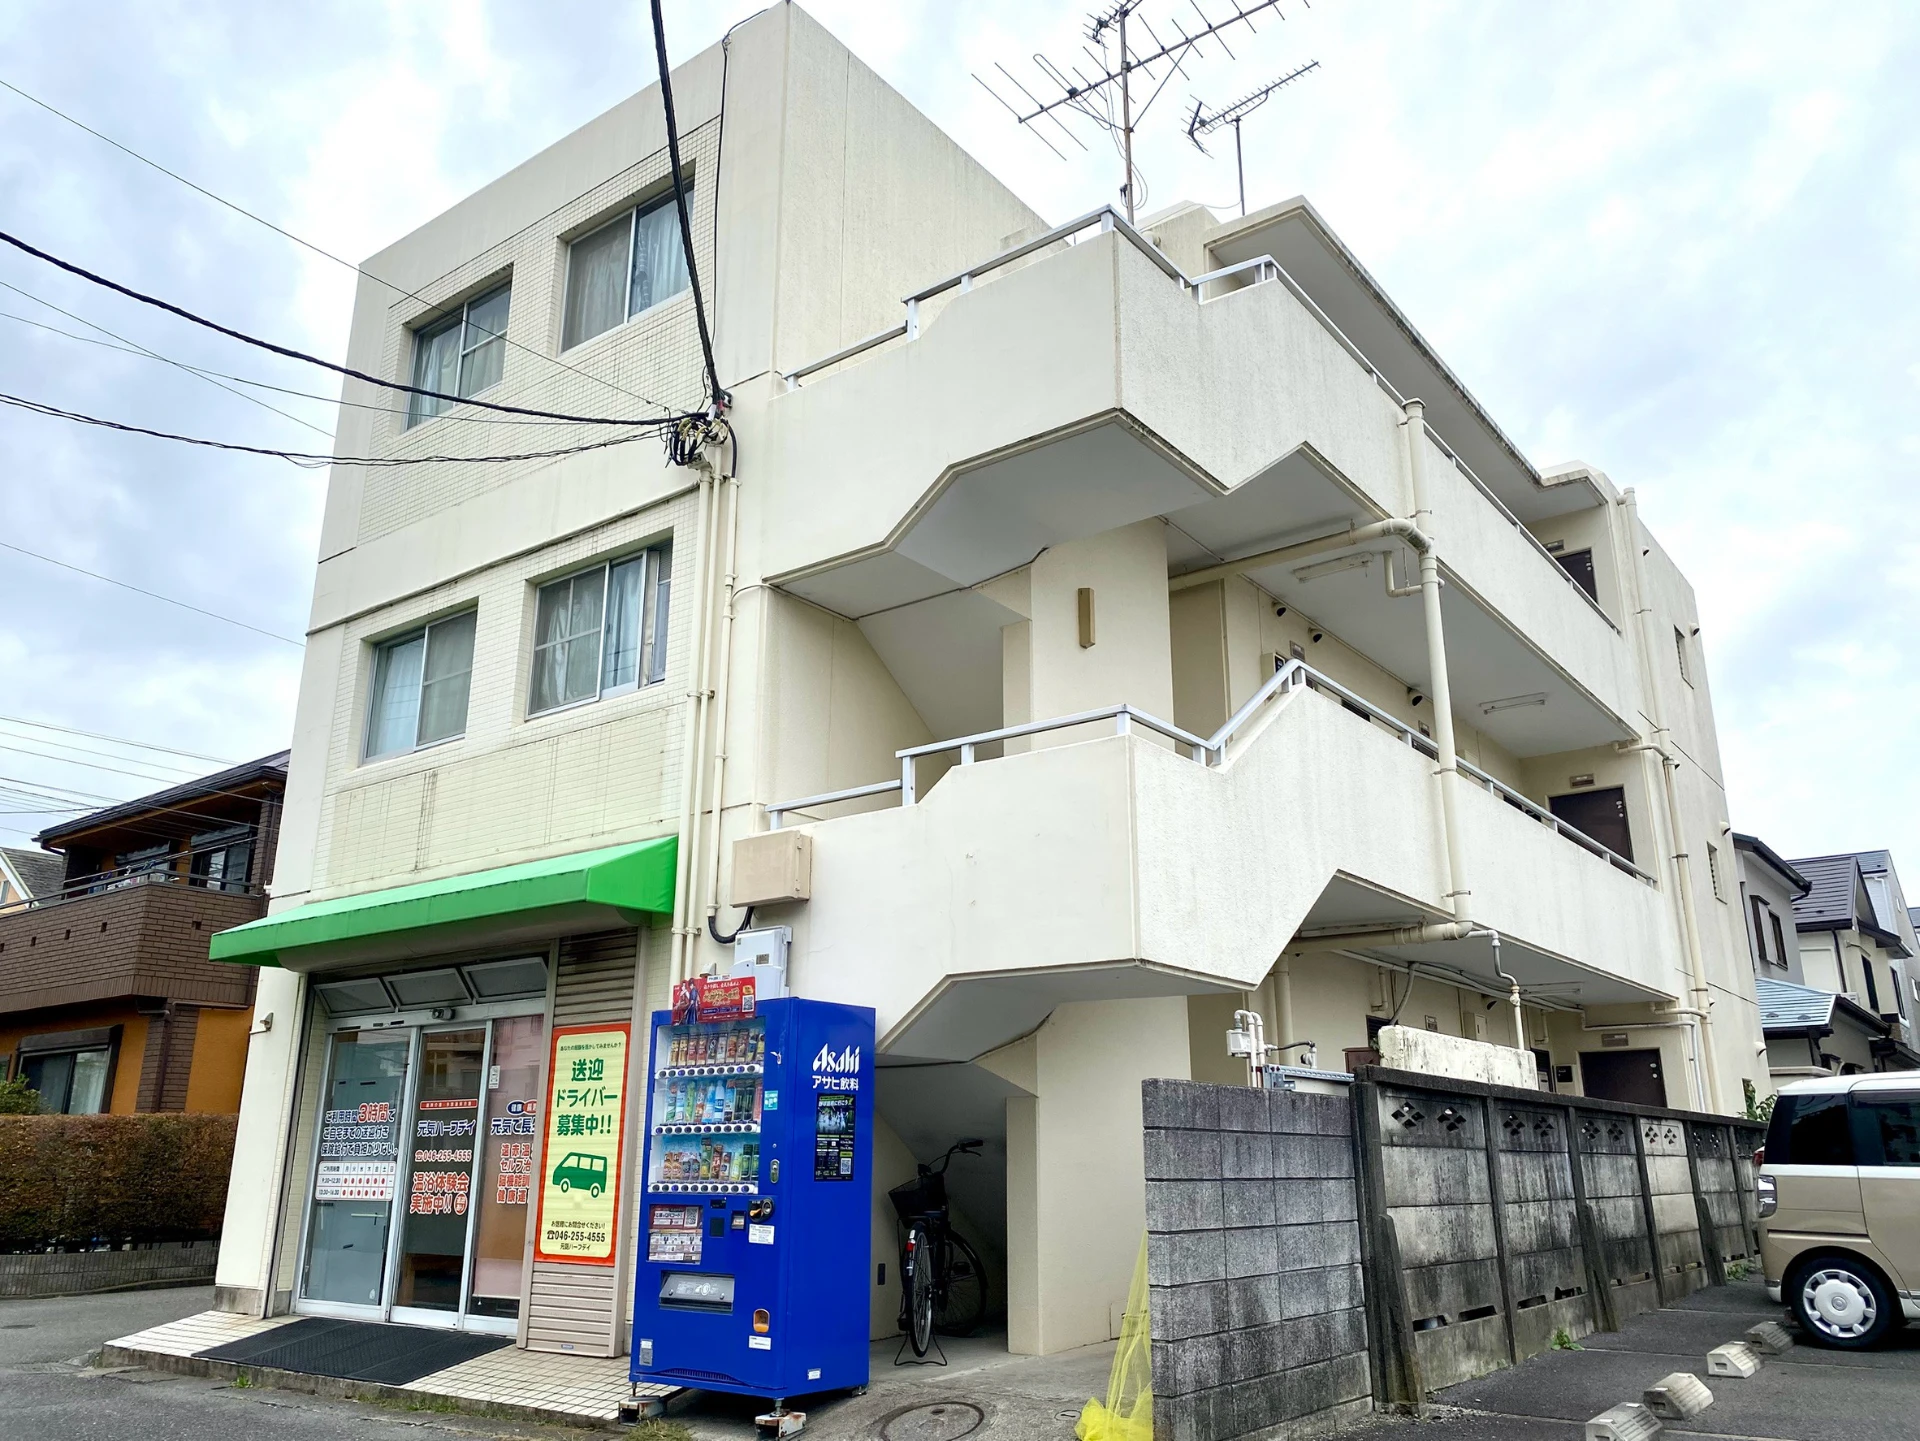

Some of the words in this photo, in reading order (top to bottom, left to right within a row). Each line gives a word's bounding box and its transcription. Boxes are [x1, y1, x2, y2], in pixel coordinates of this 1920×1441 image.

[812, 1043, 860, 1074] Asahi
[571, 1057, 604, 1082] 送迎
[812, 1075, 859, 1091] アサヒ飲料
[556, 1085, 618, 1108] ドライバー
[417, 1119, 476, 1136] 元気ハーフデイ
[557, 1113, 612, 1136] 募集中!!
[501, 1143, 533, 1158] 遠赤温
[412, 1172, 469, 1192] 温浴体験会
[410, 1194, 452, 1213] 実施中!!
[497, 1189, 527, 1203] 健康運
